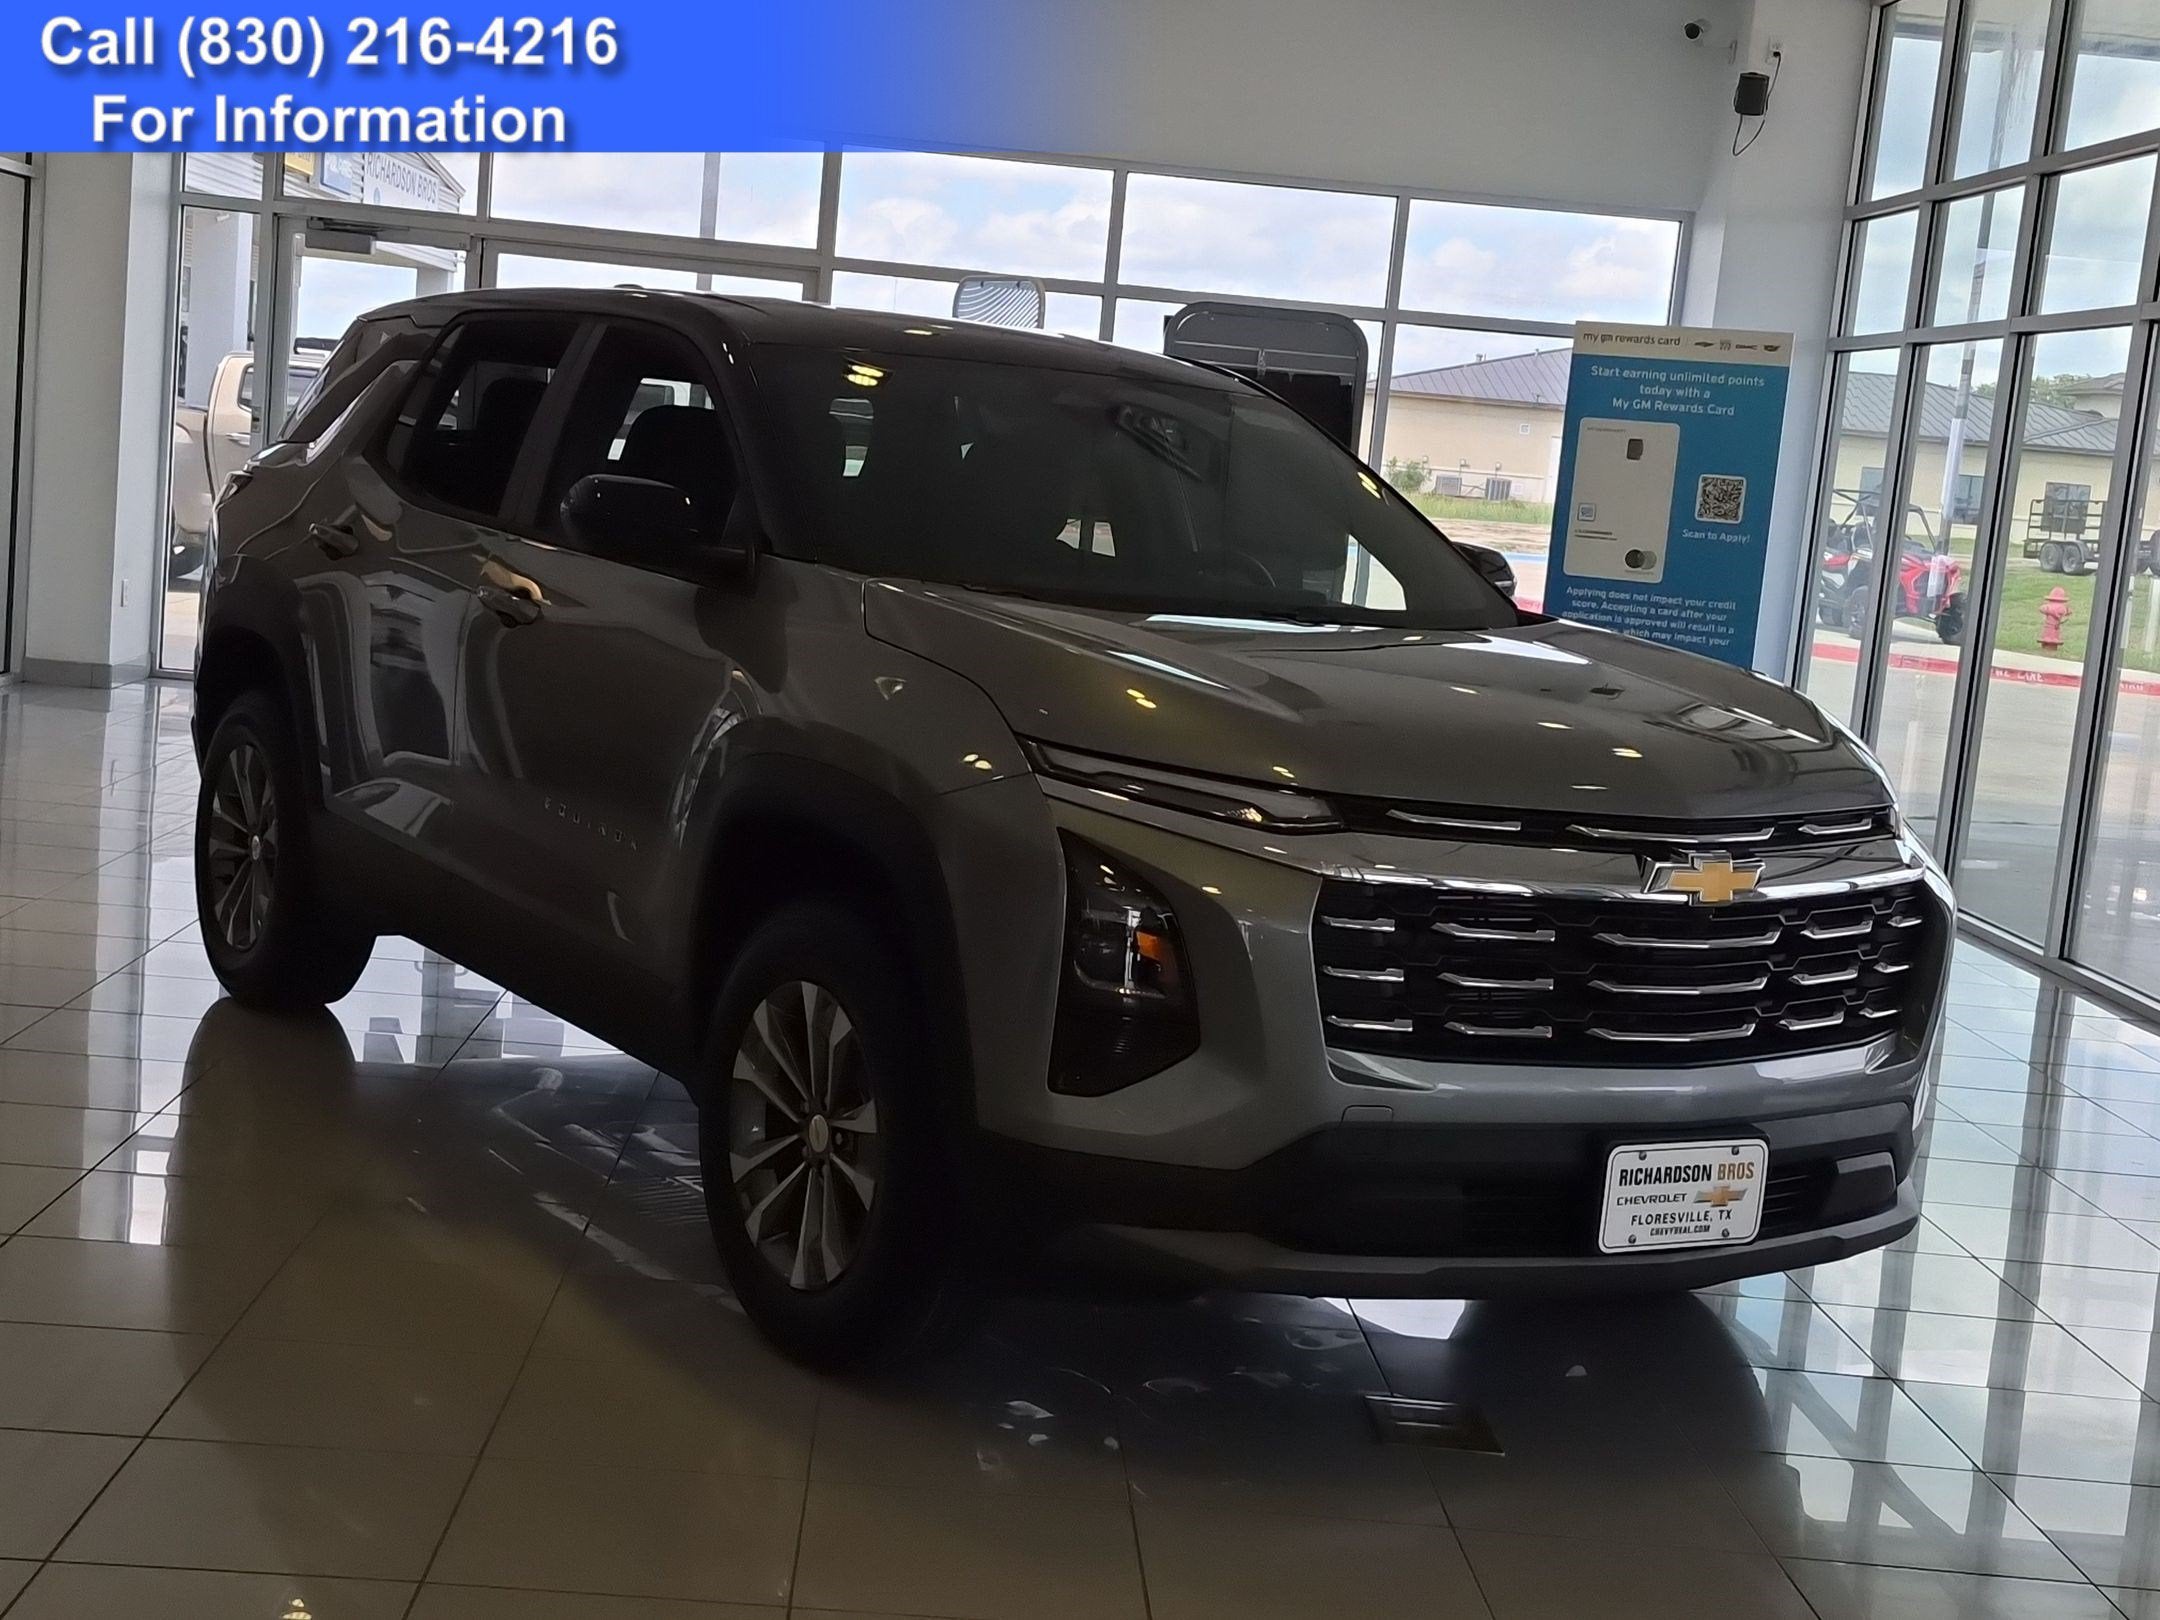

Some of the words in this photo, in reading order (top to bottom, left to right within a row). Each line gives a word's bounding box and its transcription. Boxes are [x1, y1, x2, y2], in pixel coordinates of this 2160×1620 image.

[366, 152, 417, 194] RICHARDSON
[417, 171, 438, 204] BROS
[1583, 333, 1599, 343] my
[1615, 334, 1655, 345] rewards
[1657, 336, 1681, 346] card
[1591, 365, 1620, 377] Start
[1622, 368, 1667, 382] earning
[1670, 371, 1725, 385] unlimited
[1728, 374, 1765, 388] points
[1639, 384, 1672, 397] today
[1676, 385, 1700, 398] with
[1703, 390, 1711, 399] a
[1612, 397, 1629, 410] My
[1633, 398, 1651, 410] GM
[1654, 400, 1704, 414] Rewards
[1707, 403, 1735, 416] Card
[1682, 528, 1705, 539] Scan
[1707, 531, 1717, 540] to
[1718, 532, 1751, 545] Apply!
[1566, 586, 1606, 599] Applying
[1608, 590, 1631, 600] does
[1632, 593, 1649, 602] not
[1650, 594, 1683, 606] impact
[1684, 599, 1706, 609] your
[1708, 600, 1736, 610] credit
[1572, 600, 1599, 609] score.
[1601, 601, 1648, 615] Accepting
[1650, 607, 1656, 615] a
[1657, 607, 1679, 617] card
[1680, 609, 1703, 619] after
[1706, 612, 1728, 622] your
[1562, 611, 1613, 623] application
[1614, 615, 1623, 623] is
[1624, 617, 1668, 629] approved
[1670, 619, 1686, 629] will
[1688, 621, 1715, 632] result
[1718, 623, 1727, 633] in
[1728, 627, 1735, 635] a
[1623, 628, 1650, 639] which
[1652, 631, 1672, 642] may
[1674, 632, 1706, 645] impact
[1708, 637, 1730, 647] your
[1619, 1164, 1712, 1187] RICHARDSON
[1717, 1162, 1755, 1181] BROS
[1616, 1193, 1687, 1206] CHEVROLET
[1631, 1210, 1713, 1226] FLORESVILLE,
[1718, 1209, 1732, 1221] TX
